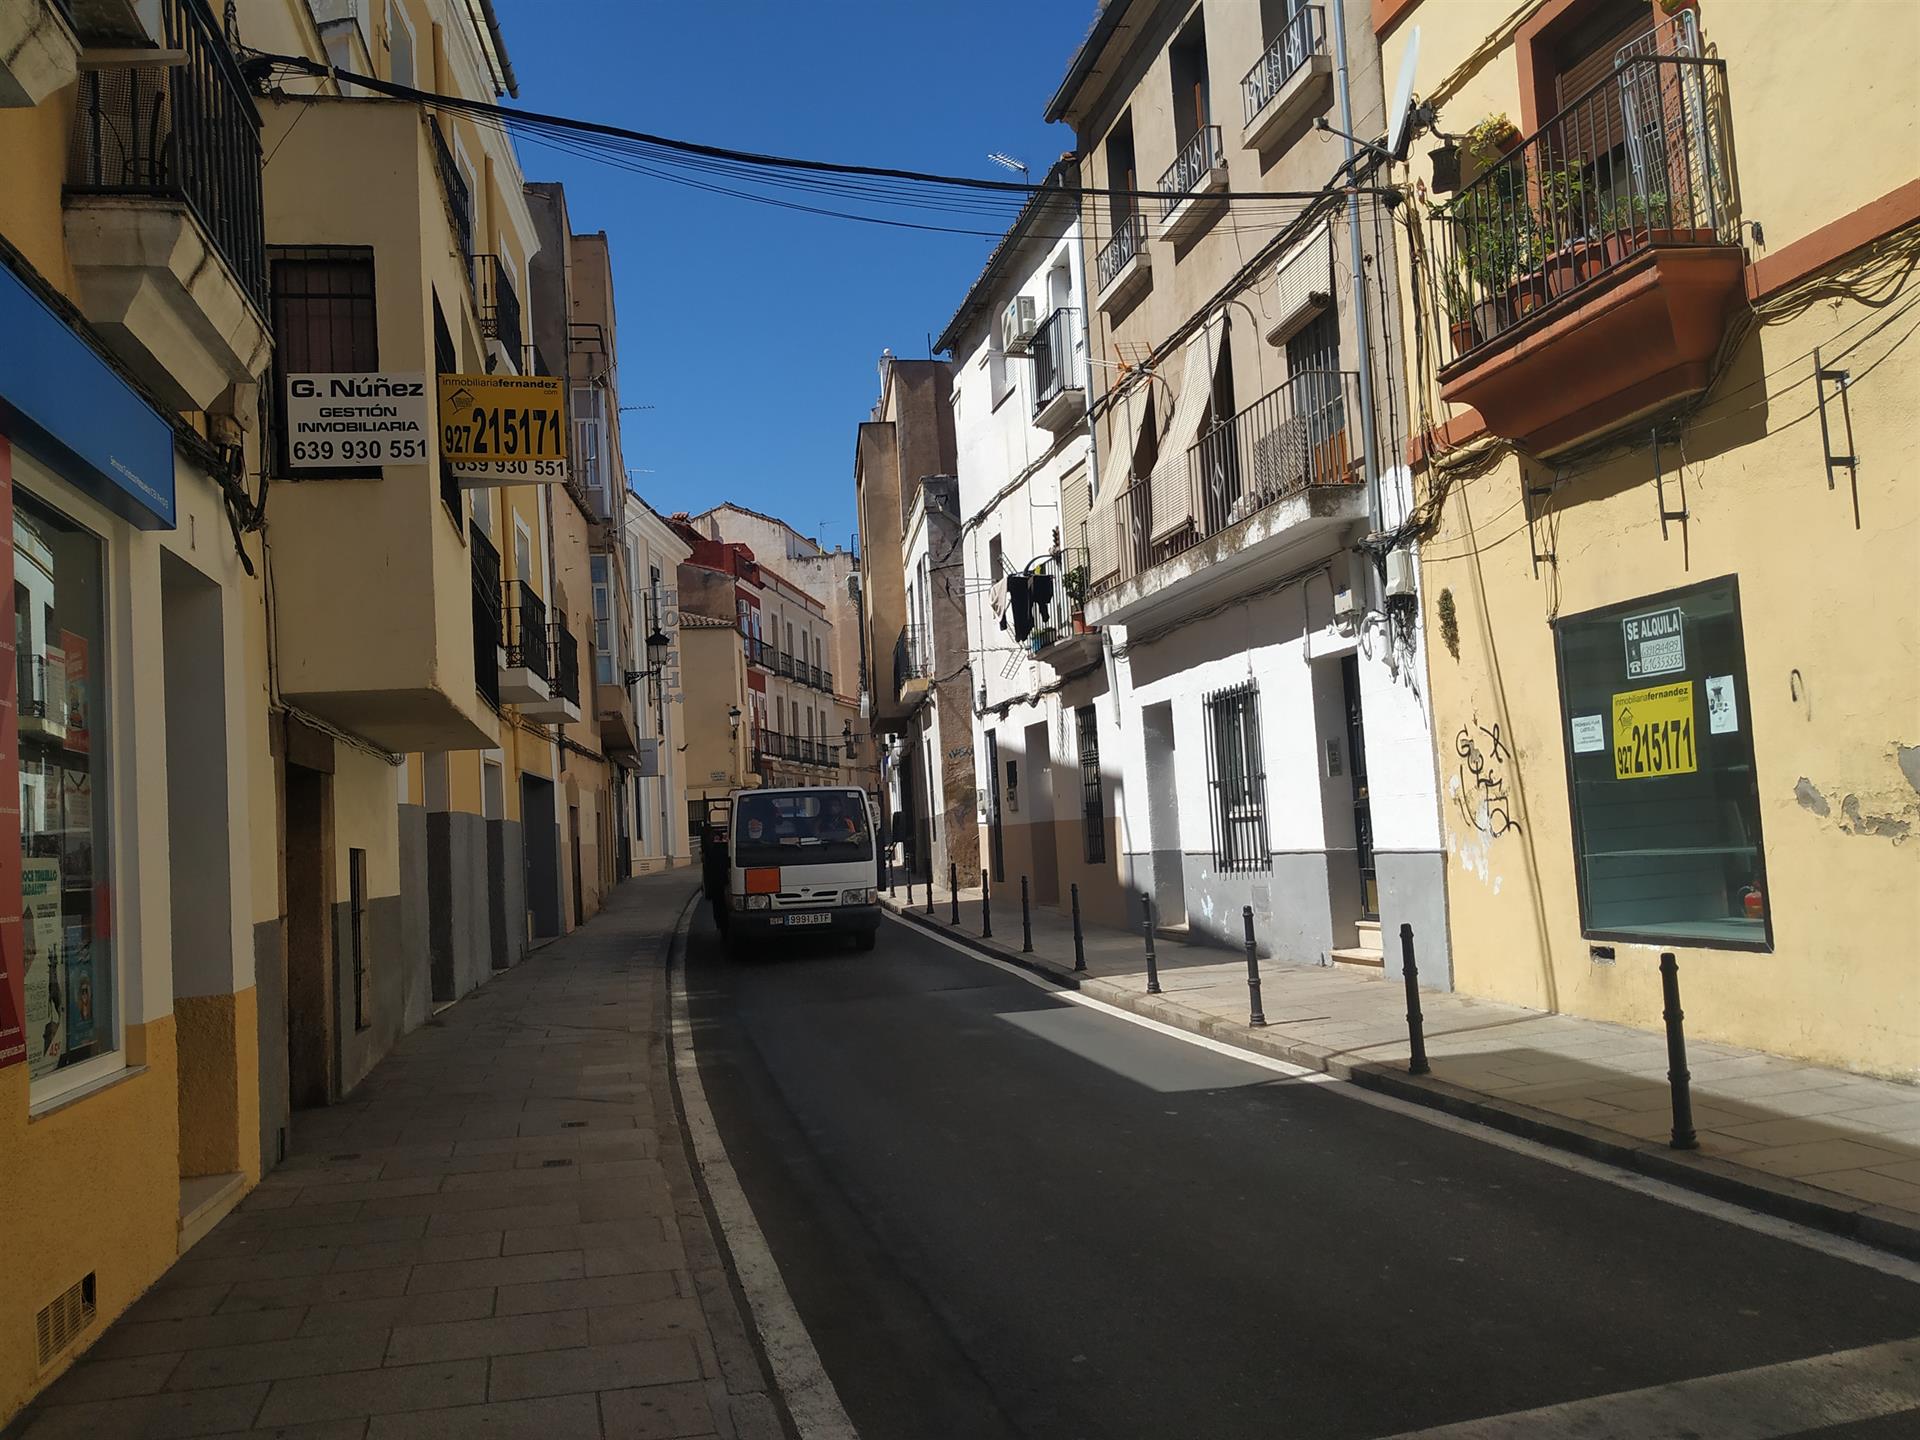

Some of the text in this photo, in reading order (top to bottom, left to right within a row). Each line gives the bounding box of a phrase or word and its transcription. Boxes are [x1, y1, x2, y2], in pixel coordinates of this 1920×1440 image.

[291, 377, 424, 397] G. Núñez
[319, 403, 397, 418] GESTIÓN
[297, 421, 420, 433] INMOBILIARIA
[445, 407, 561, 455] 927 215171
[293, 439, 426, 460] 639 930 551
[534, 460, 565, 477] 551
[1626, 613, 1680, 641] SE ALQUILA
[1617, 717, 1693, 775] 927 215171
